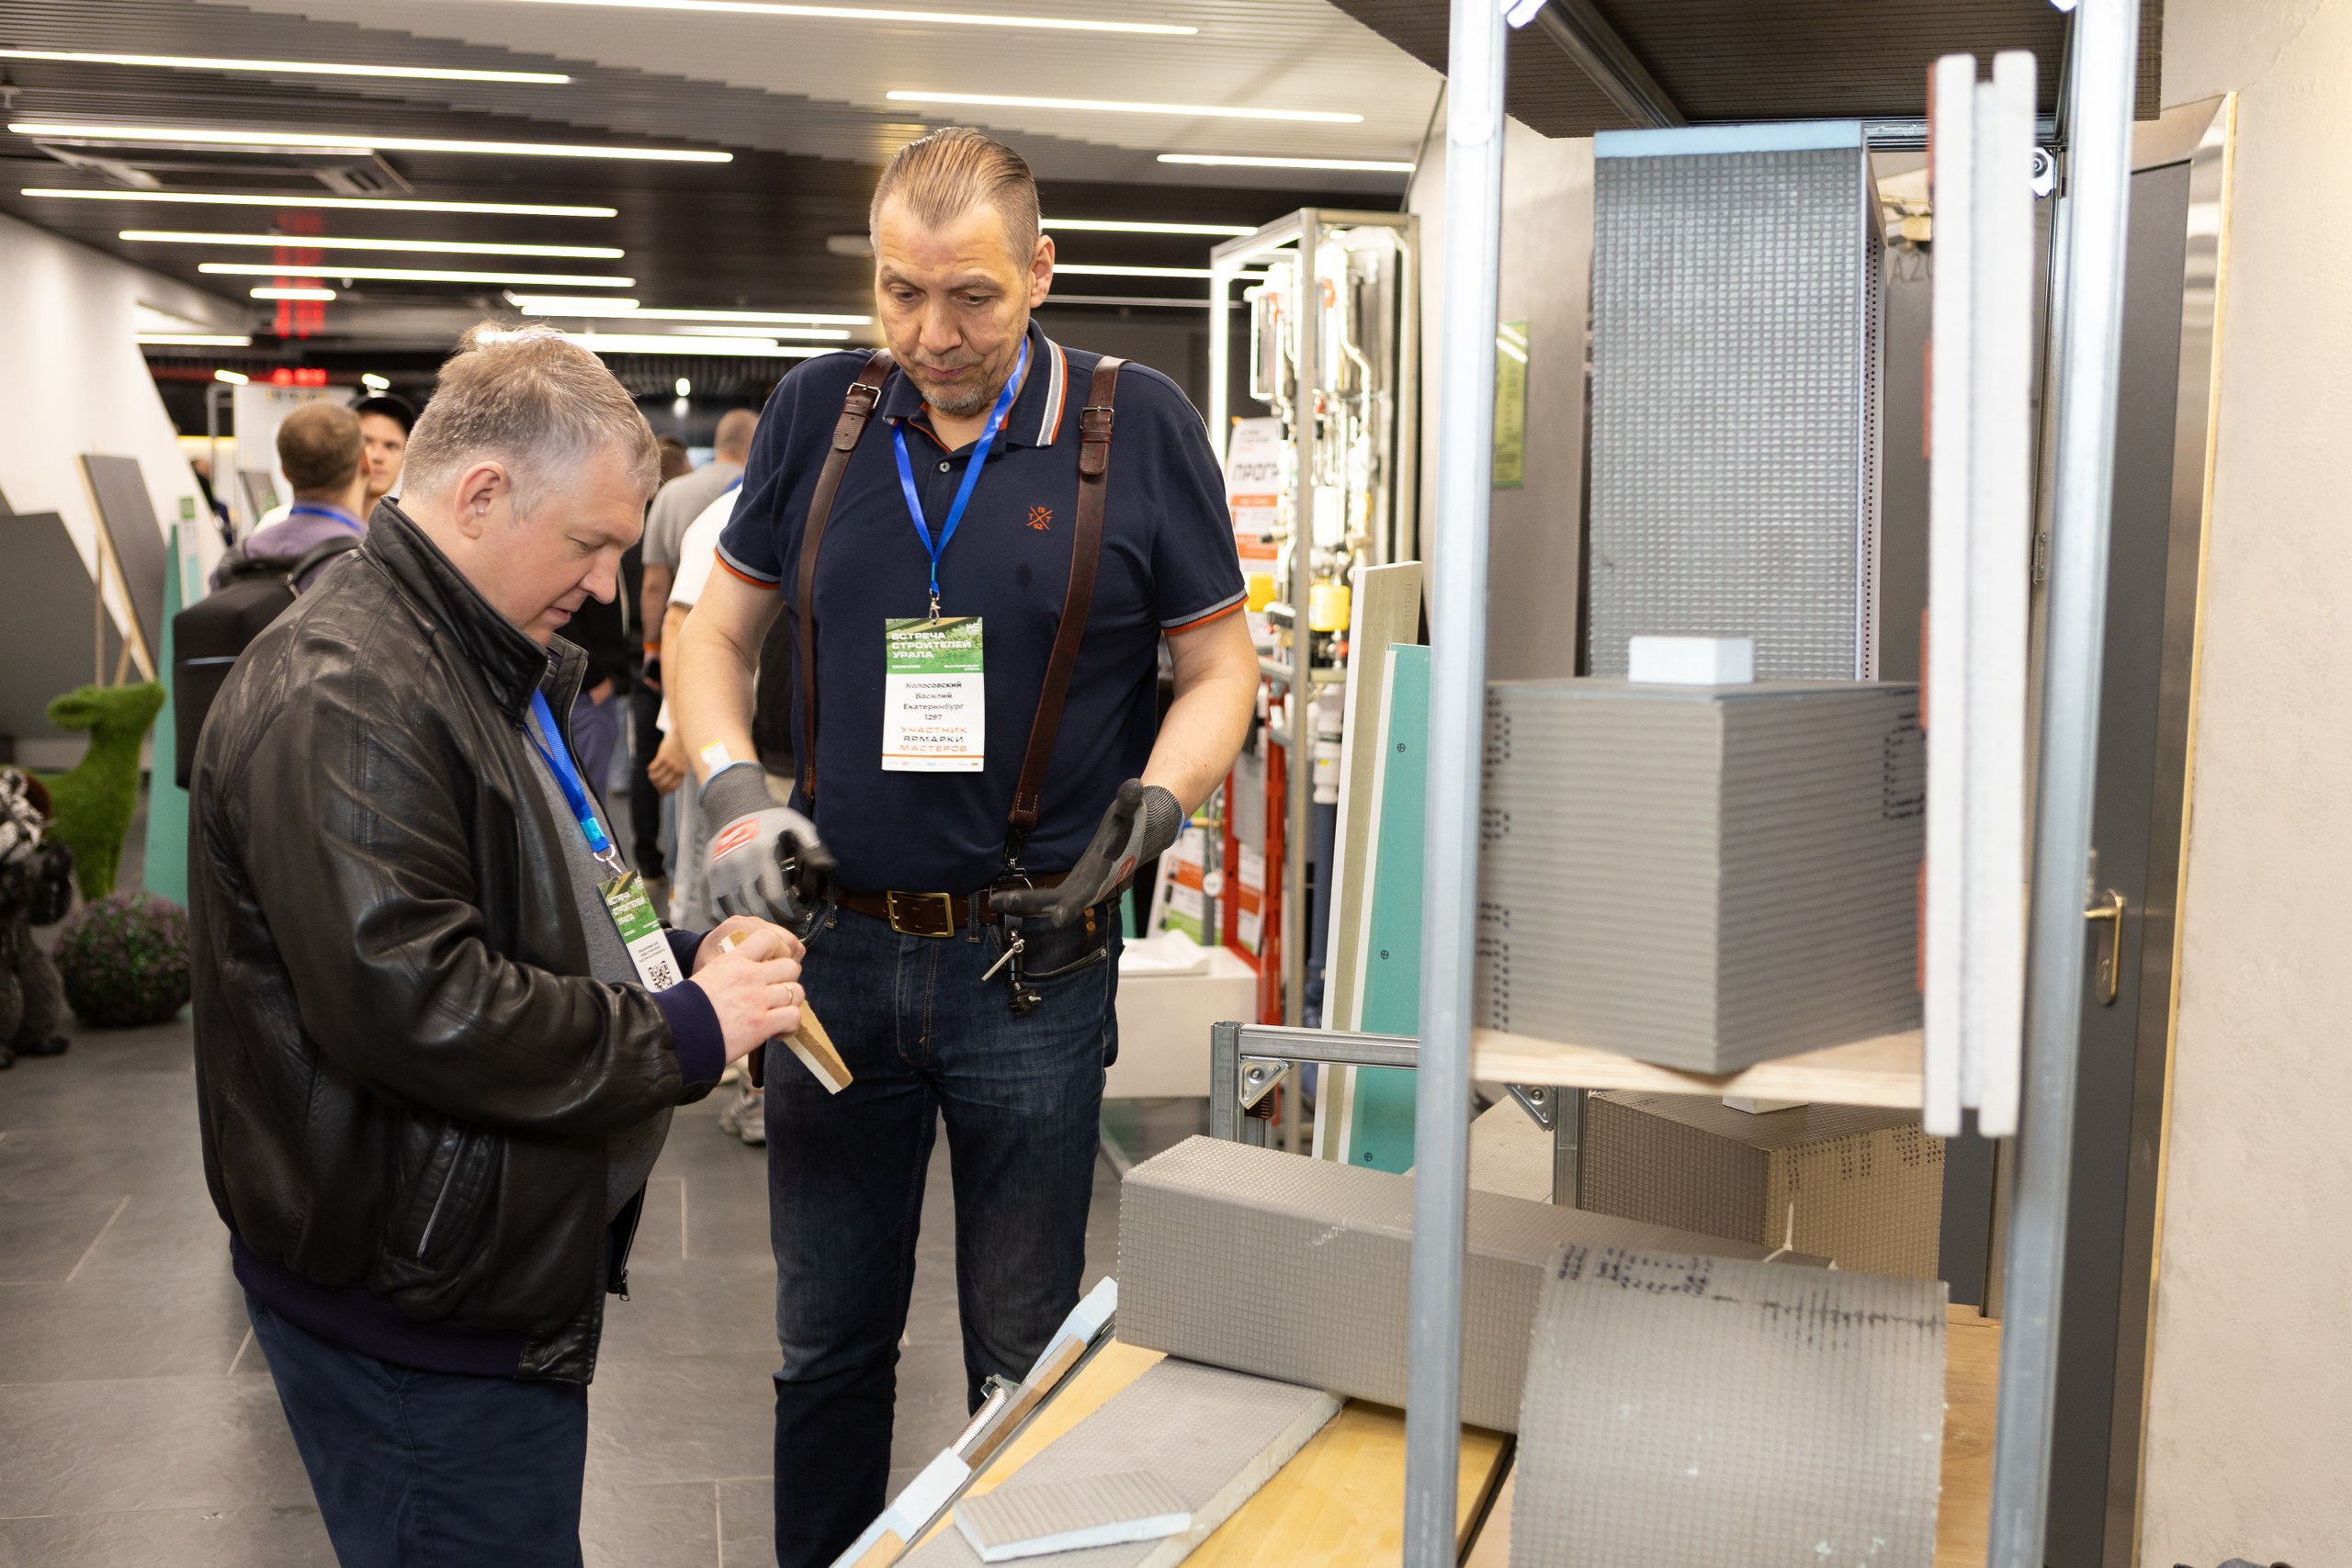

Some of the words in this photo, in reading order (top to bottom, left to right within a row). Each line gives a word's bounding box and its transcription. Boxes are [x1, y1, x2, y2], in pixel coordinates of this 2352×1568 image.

[891, 632, 946, 640] ВСТРЕЧА
[891, 640, 971, 649] СТРОИТЕЛЕЙ
[905, 681, 962, 689] Колосовский
[903, 703, 964, 711] Екатеринбург
